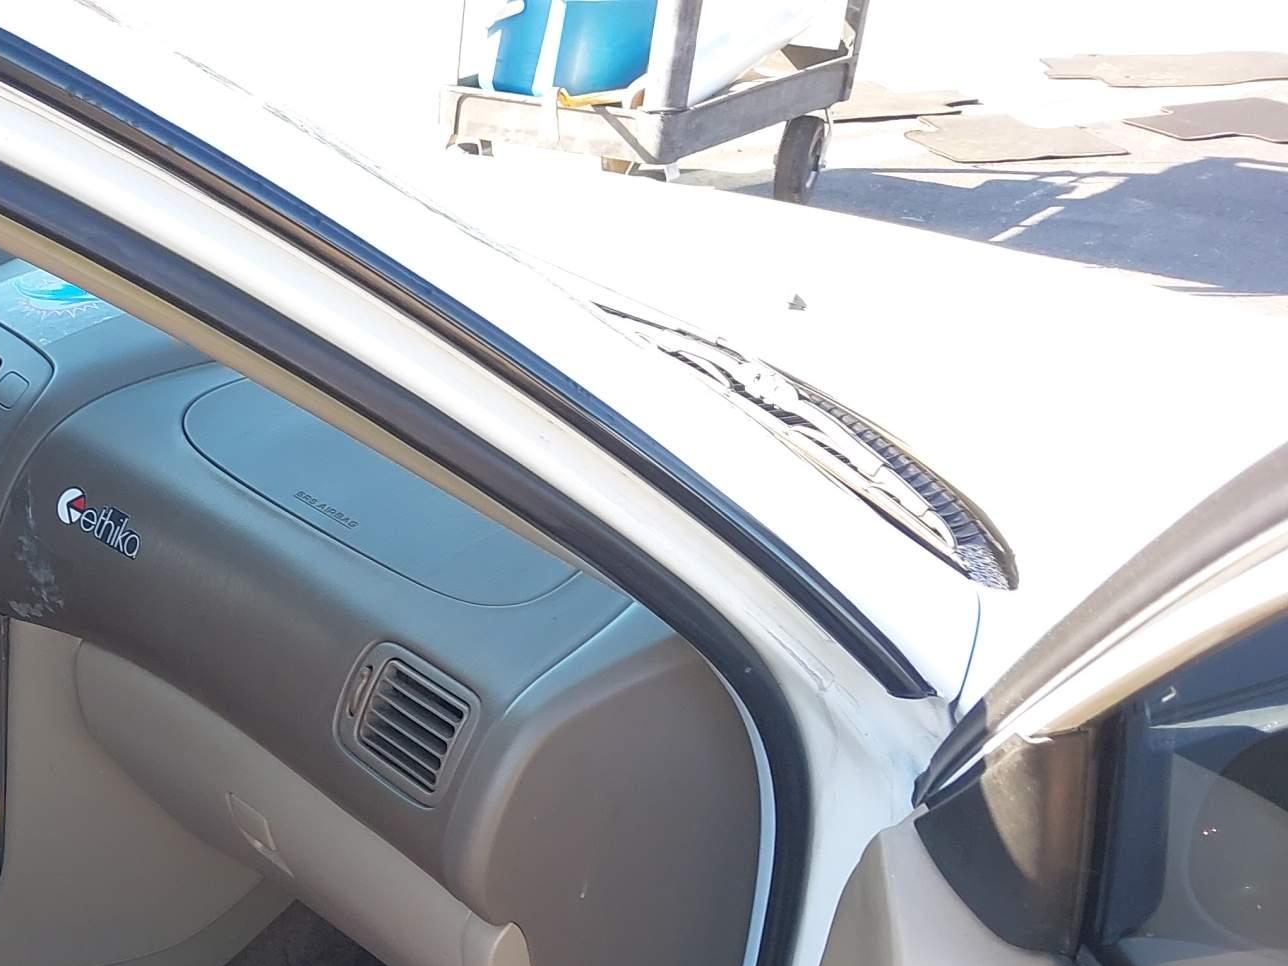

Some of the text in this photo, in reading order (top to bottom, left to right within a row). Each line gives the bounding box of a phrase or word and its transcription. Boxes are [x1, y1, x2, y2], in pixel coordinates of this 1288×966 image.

[295, 491, 358, 528] SRS AIRBAG
[80, 508, 140, 559] ethika
